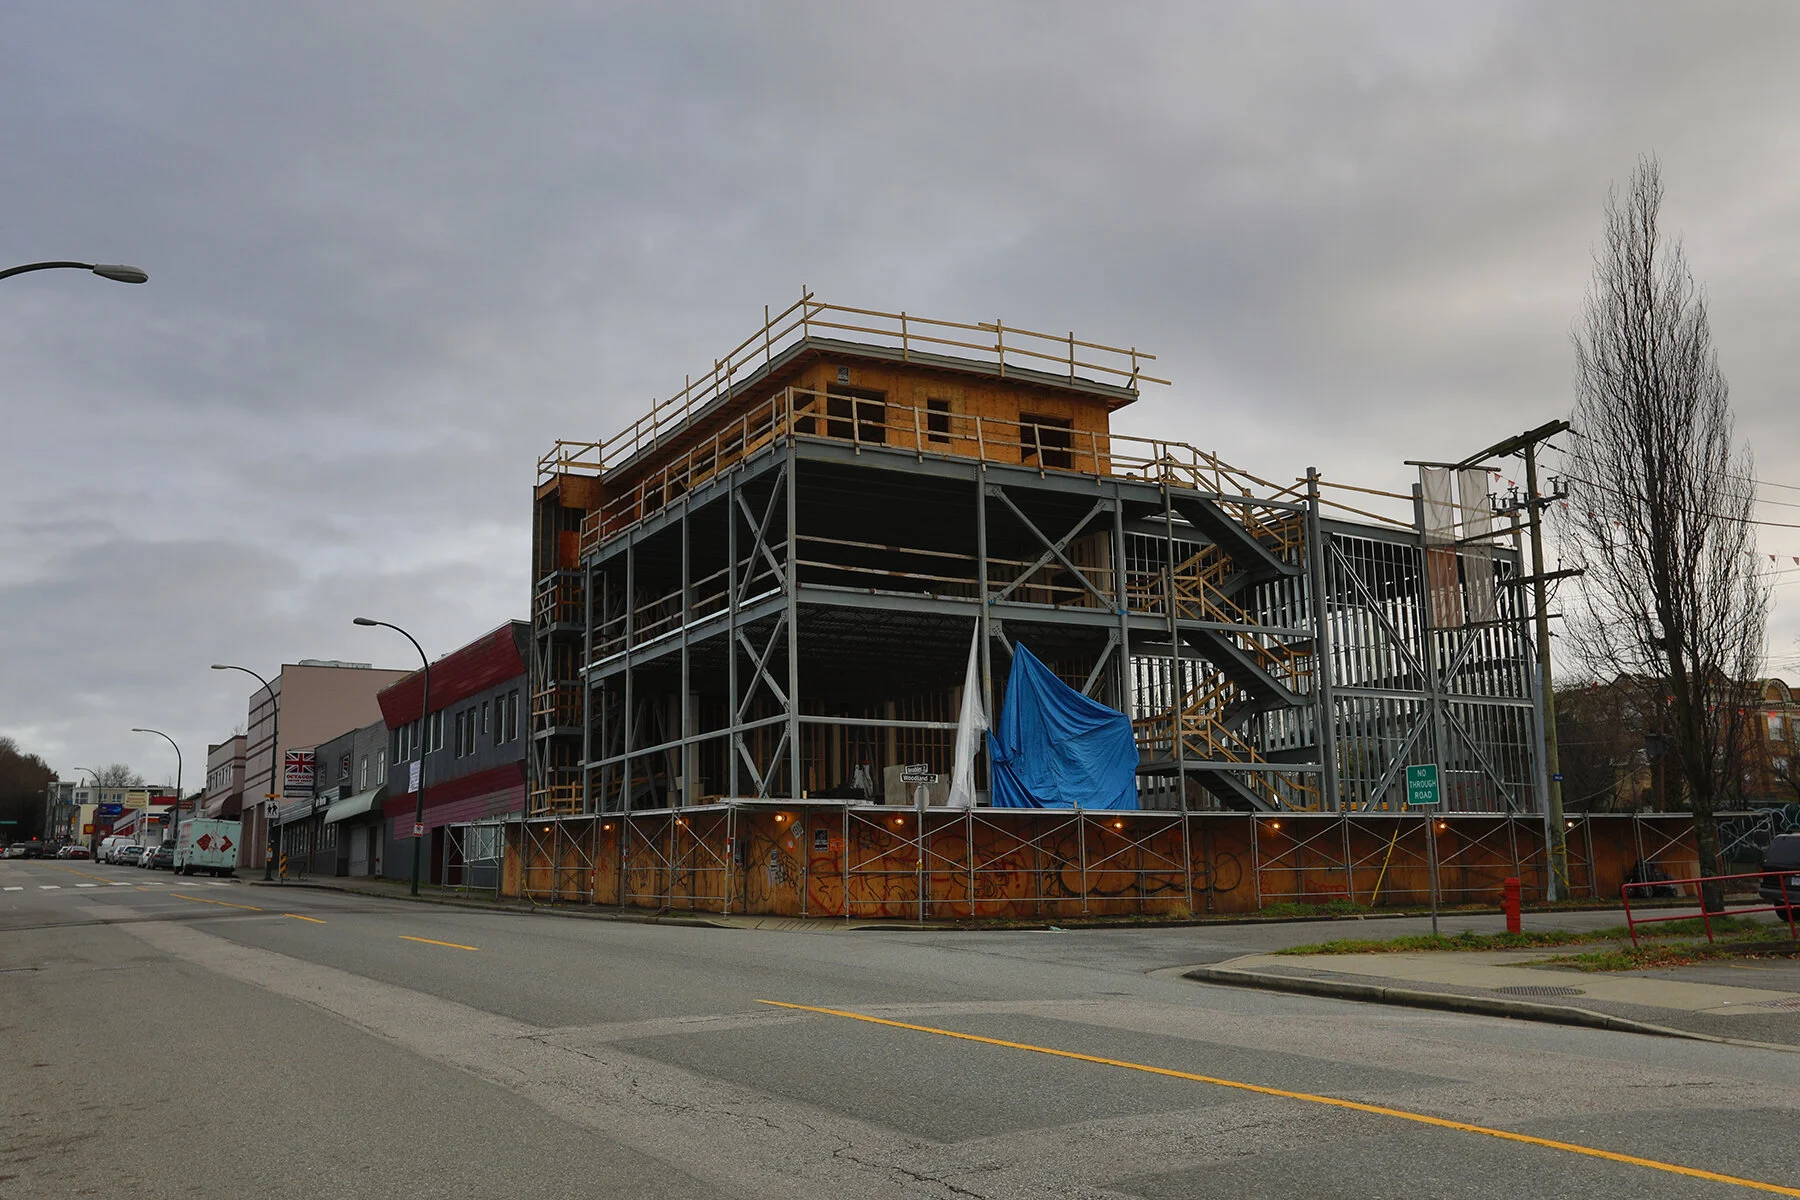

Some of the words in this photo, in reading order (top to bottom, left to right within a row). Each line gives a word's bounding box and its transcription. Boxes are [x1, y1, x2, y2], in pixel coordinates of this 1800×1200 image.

[1417, 768, 1427, 777] NO
[1409, 780, 1436, 788] THROUGH
[1414, 790, 1432, 800] ROAD
